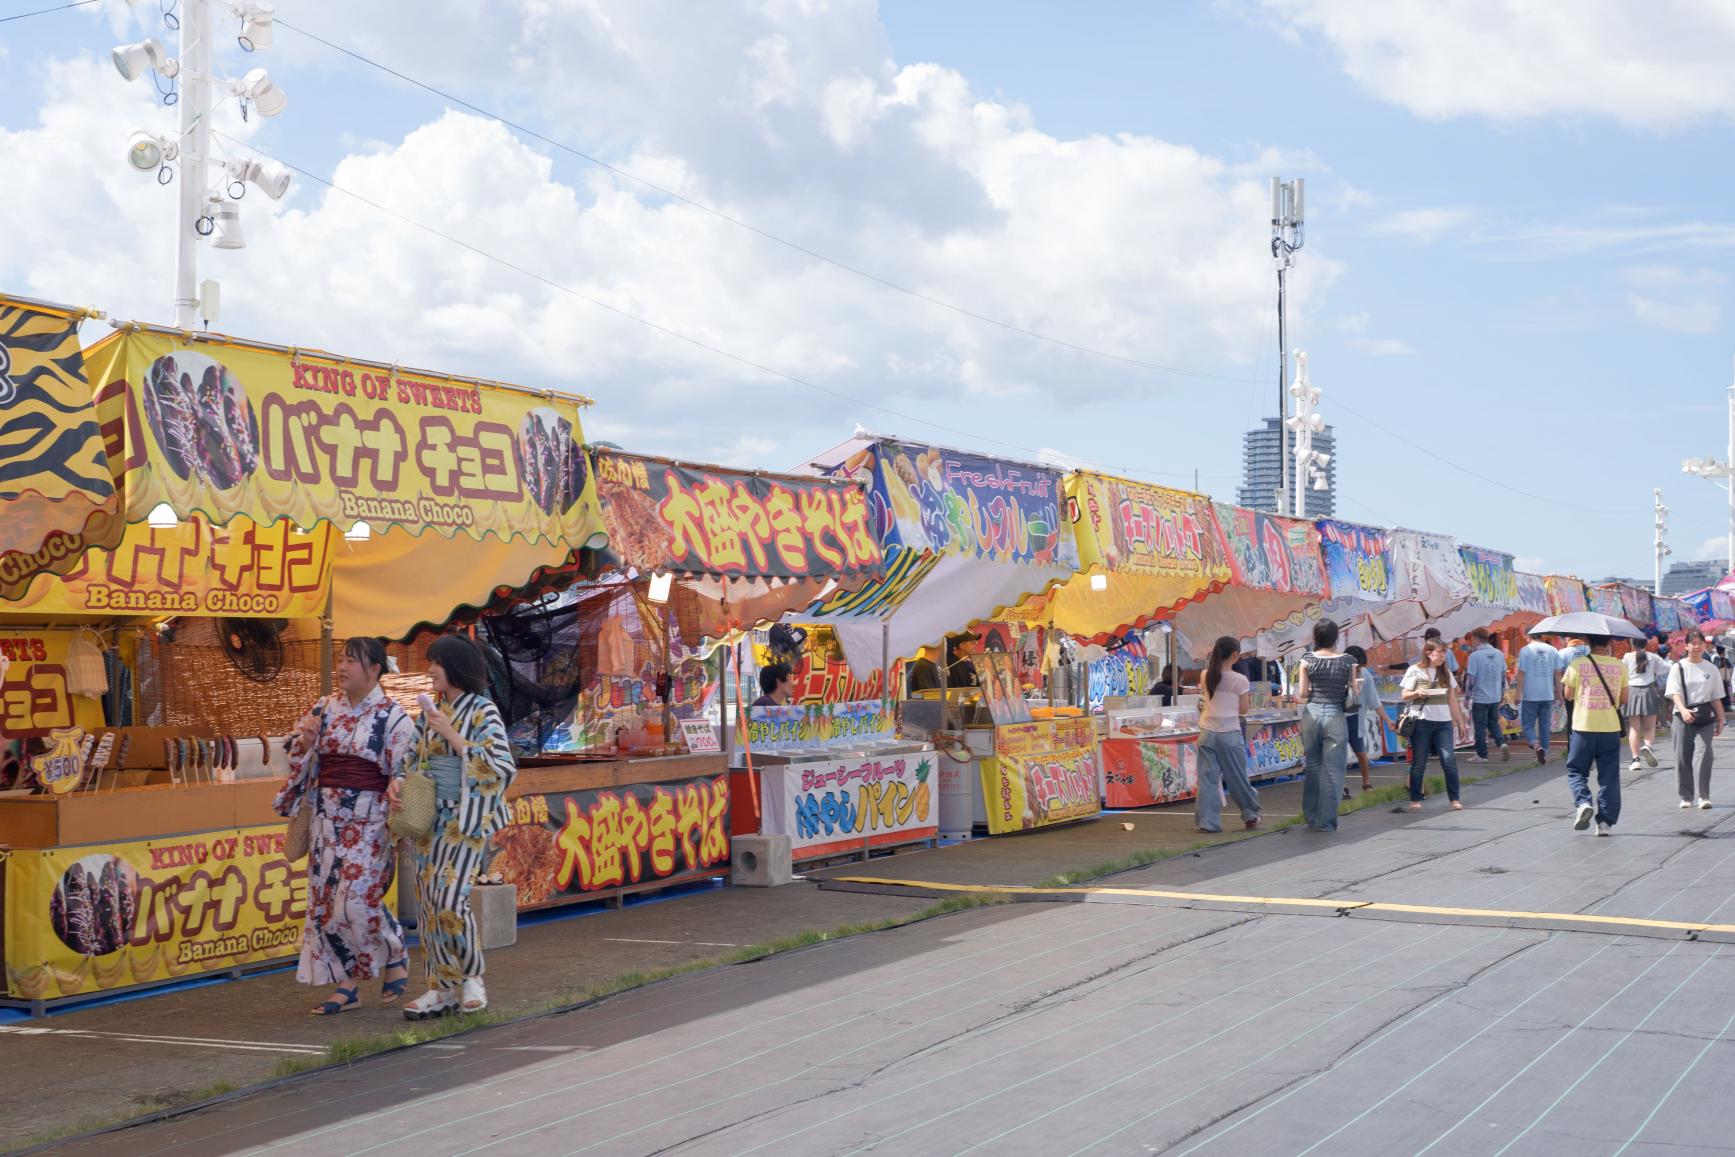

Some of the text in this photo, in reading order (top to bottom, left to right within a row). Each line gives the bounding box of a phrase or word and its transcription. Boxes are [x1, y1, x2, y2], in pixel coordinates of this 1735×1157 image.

[291, 360, 482, 414] KING OF SWEETS
[339, 490, 473, 528] Banana Choco
[659, 470, 882, 572] 大盛やきそば
[86, 583, 279, 613] Banana Choco
[44, 755, 80, 783] ¥500
[801, 759, 906, 791] ジューシーフルーツ
[795, 781, 916, 839] 冷やしパイン
[554, 774, 730, 890] 大盛やきそば
[150, 842, 207, 870] KING
[212, 838, 239, 861] OF
[177, 925, 298, 965] Banana Choco
